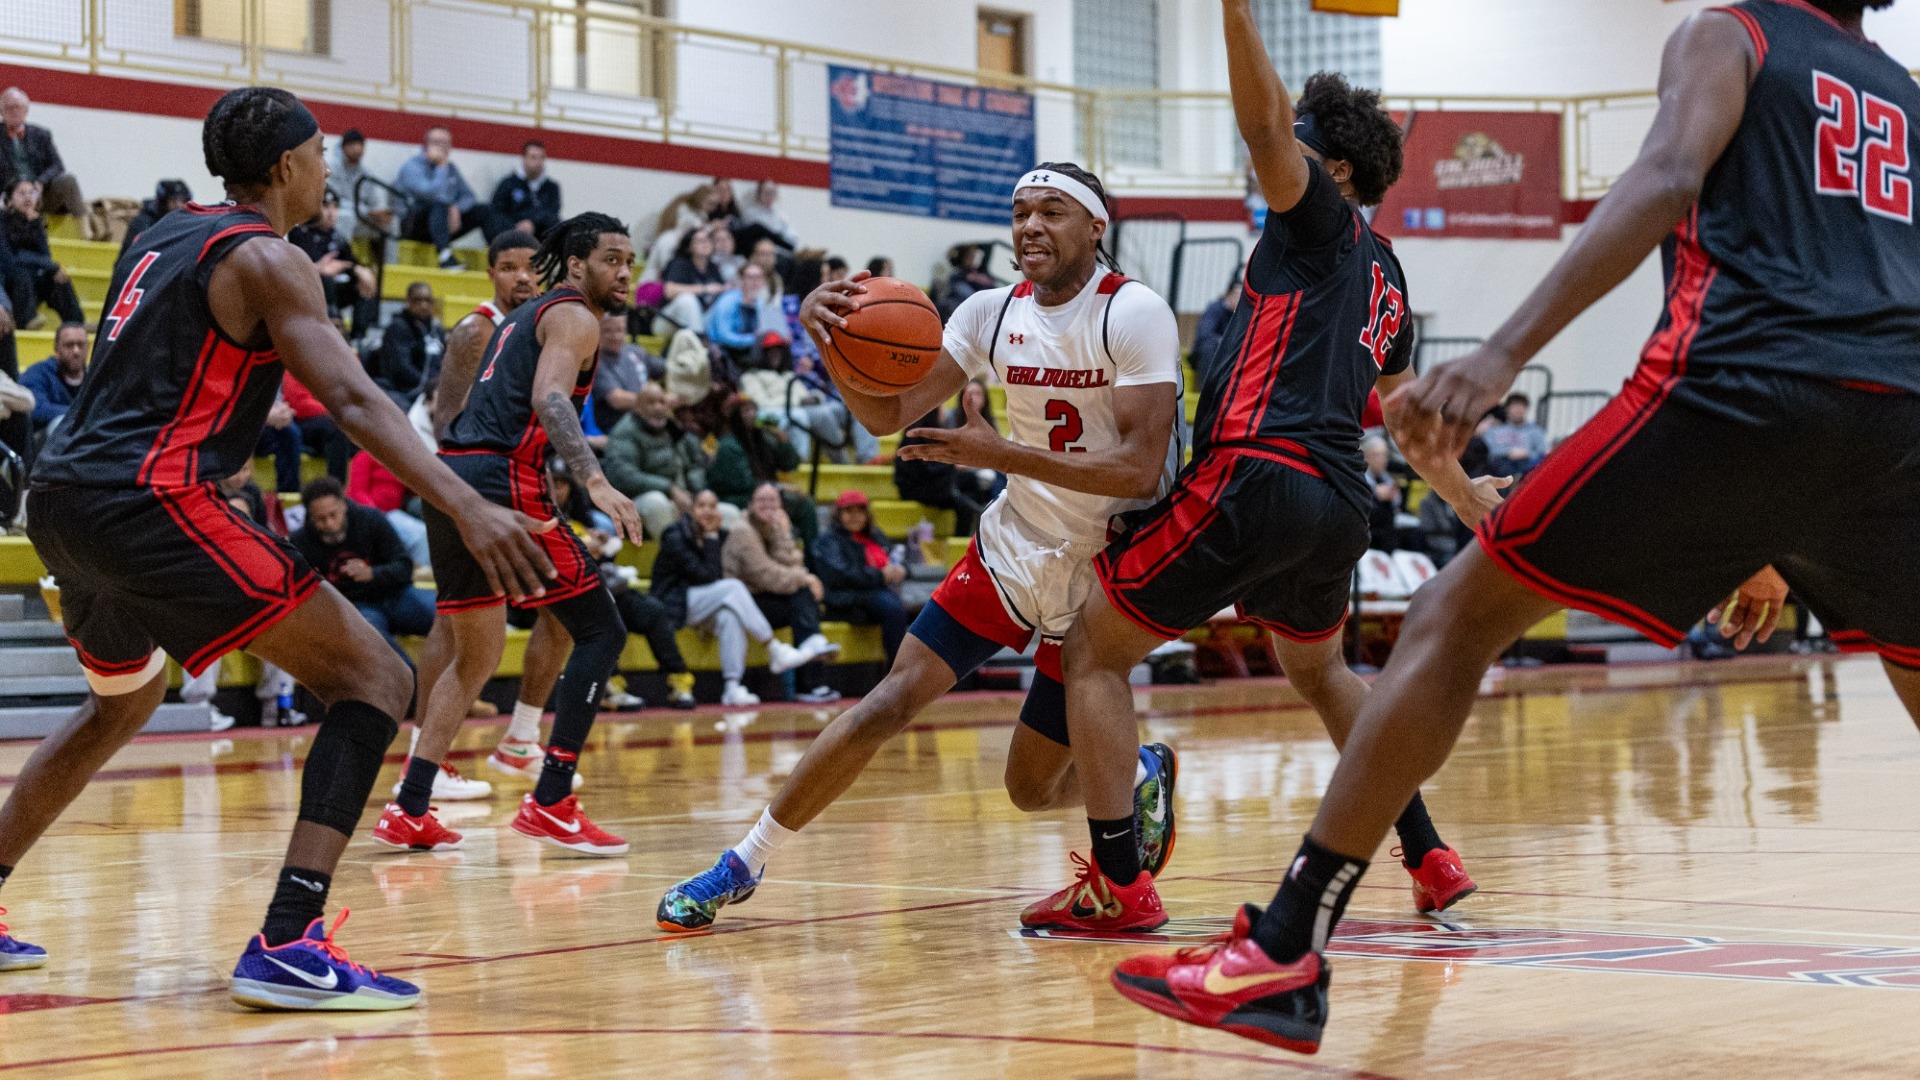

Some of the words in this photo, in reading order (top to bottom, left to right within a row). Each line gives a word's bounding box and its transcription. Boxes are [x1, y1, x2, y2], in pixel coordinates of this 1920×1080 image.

[1812, 69, 1913, 226] 22
[106, 251, 161, 341] 4
[1359, 260, 1404, 371] 12
[480, 321, 516, 382] 1
[890, 351, 919, 364] ROCK
[1045, 399, 1087, 453] 2
